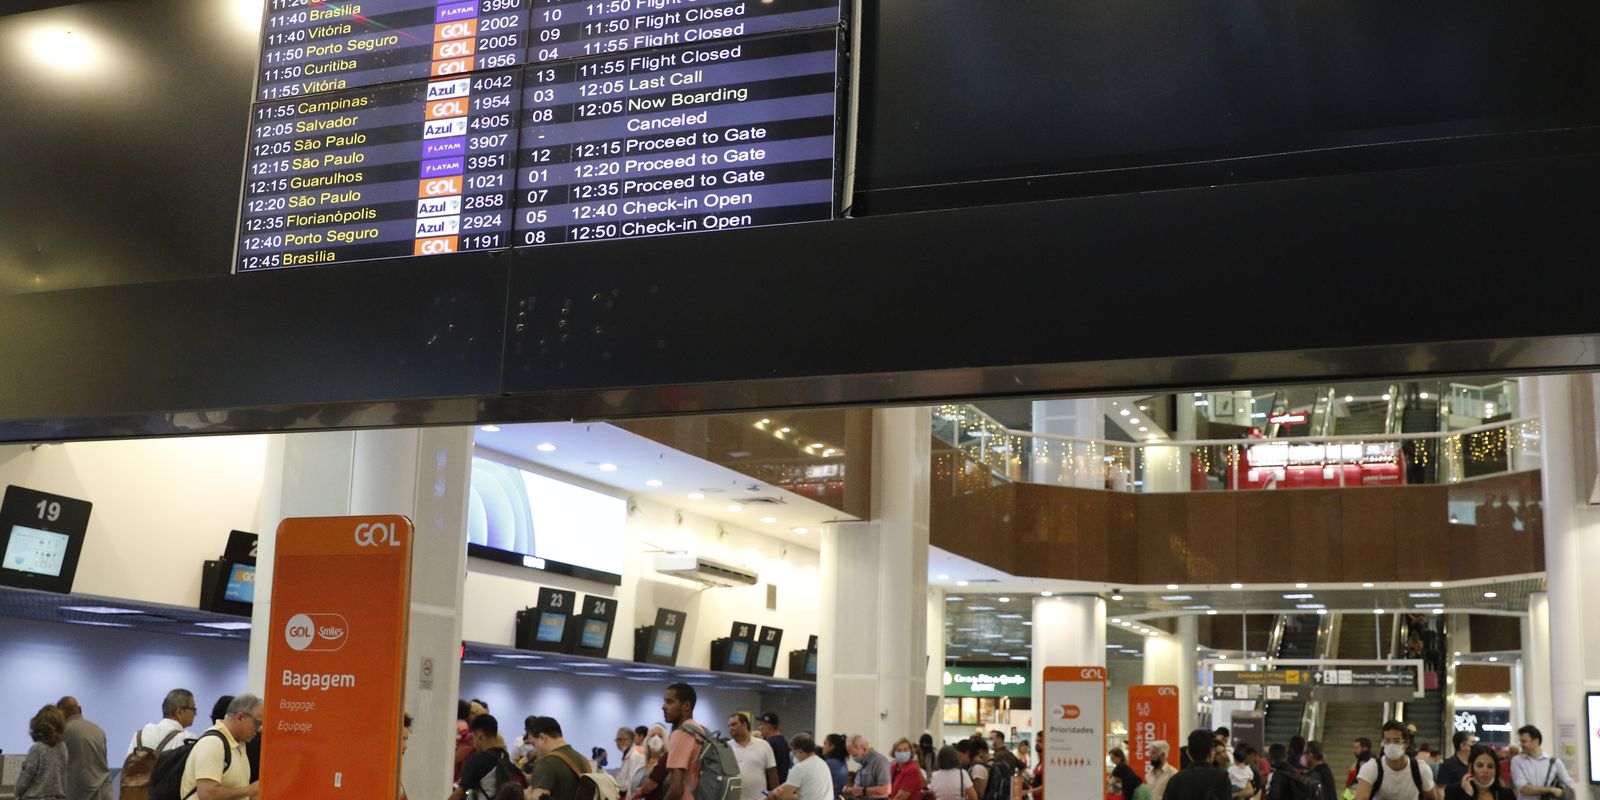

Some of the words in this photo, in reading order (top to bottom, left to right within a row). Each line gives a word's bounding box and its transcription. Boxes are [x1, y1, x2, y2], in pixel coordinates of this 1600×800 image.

[269, 30, 304, 45] 11:40
[309, 25, 351, 38] Vitória
[448, 7, 473, 15] LATAM
[483, 0, 519, 11] 3990
[271, 12, 306, 27] 11:40
[310, 5, 360, 21] Brasília
[541, 29, 560, 41] 09
[586, 19, 629, 35] 11:50
[636, 12, 680, 28] Flight
[686, 3, 744, 21] Closed
[544, 9, 561, 21] 10
[587, 0, 630, 15] 11:50
[267, 48, 303, 63] 11:50
[307, 44, 342, 57] Porto
[347, 36, 397, 50] Seguro
[441, 23, 471, 38] GOL
[481, 15, 518, 31] 2002
[539, 48, 558, 61] 04
[584, 39, 628, 54] 11:55
[634, 32, 679, 48] Flight
[685, 23, 744, 41] Closed
[266, 66, 301, 80] 11:50
[305, 60, 356, 75] Curitiba
[440, 42, 469, 57] GOL
[479, 35, 516, 50] 2005
[537, 70, 555, 82] 13
[581, 60, 624, 76] 11:55
[631, 54, 675, 70] Flight
[682, 45, 740, 63] Closed
[263, 84, 299, 99] 11:55
[303, 79, 345, 93] Vitória
[438, 61, 468, 75] GOL
[479, 54, 515, 68] 1956
[534, 89, 553, 102] 03
[580, 80, 623, 96] 12:05
[630, 76, 664, 90] Last
[670, 71, 702, 85] Call
[259, 105, 294, 119] 11:55
[298, 97, 367, 113] Campinas
[429, 85, 455, 97] Azul
[474, 76, 511, 90] 4042
[533, 109, 552, 122] 08
[579, 101, 622, 116] 12:05
[629, 99, 665, 110] Now
[672, 88, 747, 105] Boarding
[256, 123, 292, 137] 12:05
[296, 117, 358, 132] Salvador
[432, 102, 462, 116] GOL
[474, 95, 510, 109] 1954
[627, 111, 707, 131] Canceled
[255, 142, 290, 156] 12:05
[294, 139, 321, 151] São
[326, 134, 365, 147] Paulo
[426, 123, 452, 135] Azul
[471, 115, 509, 129] 4905
[532, 149, 550, 162] 12
[576, 142, 620, 157] 12:15
[627, 133, 696, 152] Proceed
[703, 129, 718, 143] to
[725, 127, 766, 141] Gate
[252, 160, 288, 174] 12:15
[292, 158, 319, 169] São
[324, 152, 364, 166] Paulo
[470, 134, 507, 149] 3907
[529, 170, 547, 182] 01
[575, 162, 619, 177] 12:20
[626, 154, 695, 172] Proceed
[702, 150, 717, 165] to
[724, 148, 765, 162] Gate
[251, 179, 286, 193] 12:15
[291, 173, 362, 188] Guarulhos
[468, 155, 504, 169] 3951
[528, 190, 548, 203] 07
[574, 183, 618, 198] 12:35
[625, 175, 694, 193] Proceed
[701, 171, 716, 186] to
[723, 170, 764, 183] Gate
[249, 198, 285, 212] 12:20
[289, 196, 315, 207] São
[321, 191, 360, 204] Paulo
[426, 180, 456, 195] GOL
[468, 174, 502, 188] 1021
[527, 210, 546, 223] 05
[573, 204, 617, 219] 12:40
[623, 197, 697, 214] Check-in
[704, 194, 752, 208] Open
[247, 217, 283, 230] 12:35
[287, 208, 376, 226] Florianópolis
[419, 202, 445, 213] Azul
[465, 194, 503, 209] 2858
[245, 236, 281, 249] 12:40
[285, 234, 321, 245] Porto
[327, 229, 378, 242] Seguro
[418, 222, 444, 233] Azul
[464, 215, 501, 229] 2924
[525, 231, 547, 245] 08
[572, 225, 618, 241] 12:50
[622, 218, 699, 236] Check-in
[703, 216, 751, 230] Open
[243, 255, 279, 268] 12:45
[283, 251, 335, 265] Brasília
[421, 239, 452, 255] GOL
[464, 235, 501, 249] 1191
[36, 499, 61, 521] 19
[353, 522, 400, 547] GOL
[550, 593, 563, 607] 23
[593, 601, 607, 615] 24
[289, 625, 311, 638] GOL
[318, 625, 344, 640] Smiles
[665, 613, 677, 626] 25
[766, 630, 776, 641] 27
[282, 669, 356, 691] Bagagem
[1080, 669, 1104, 680] GOL
[279, 699, 315, 711] Baggage
[1157, 686, 1177, 697] GOL
[277, 719, 313, 733] Equipaje
[1050, 726, 1094, 735] Prioridades
